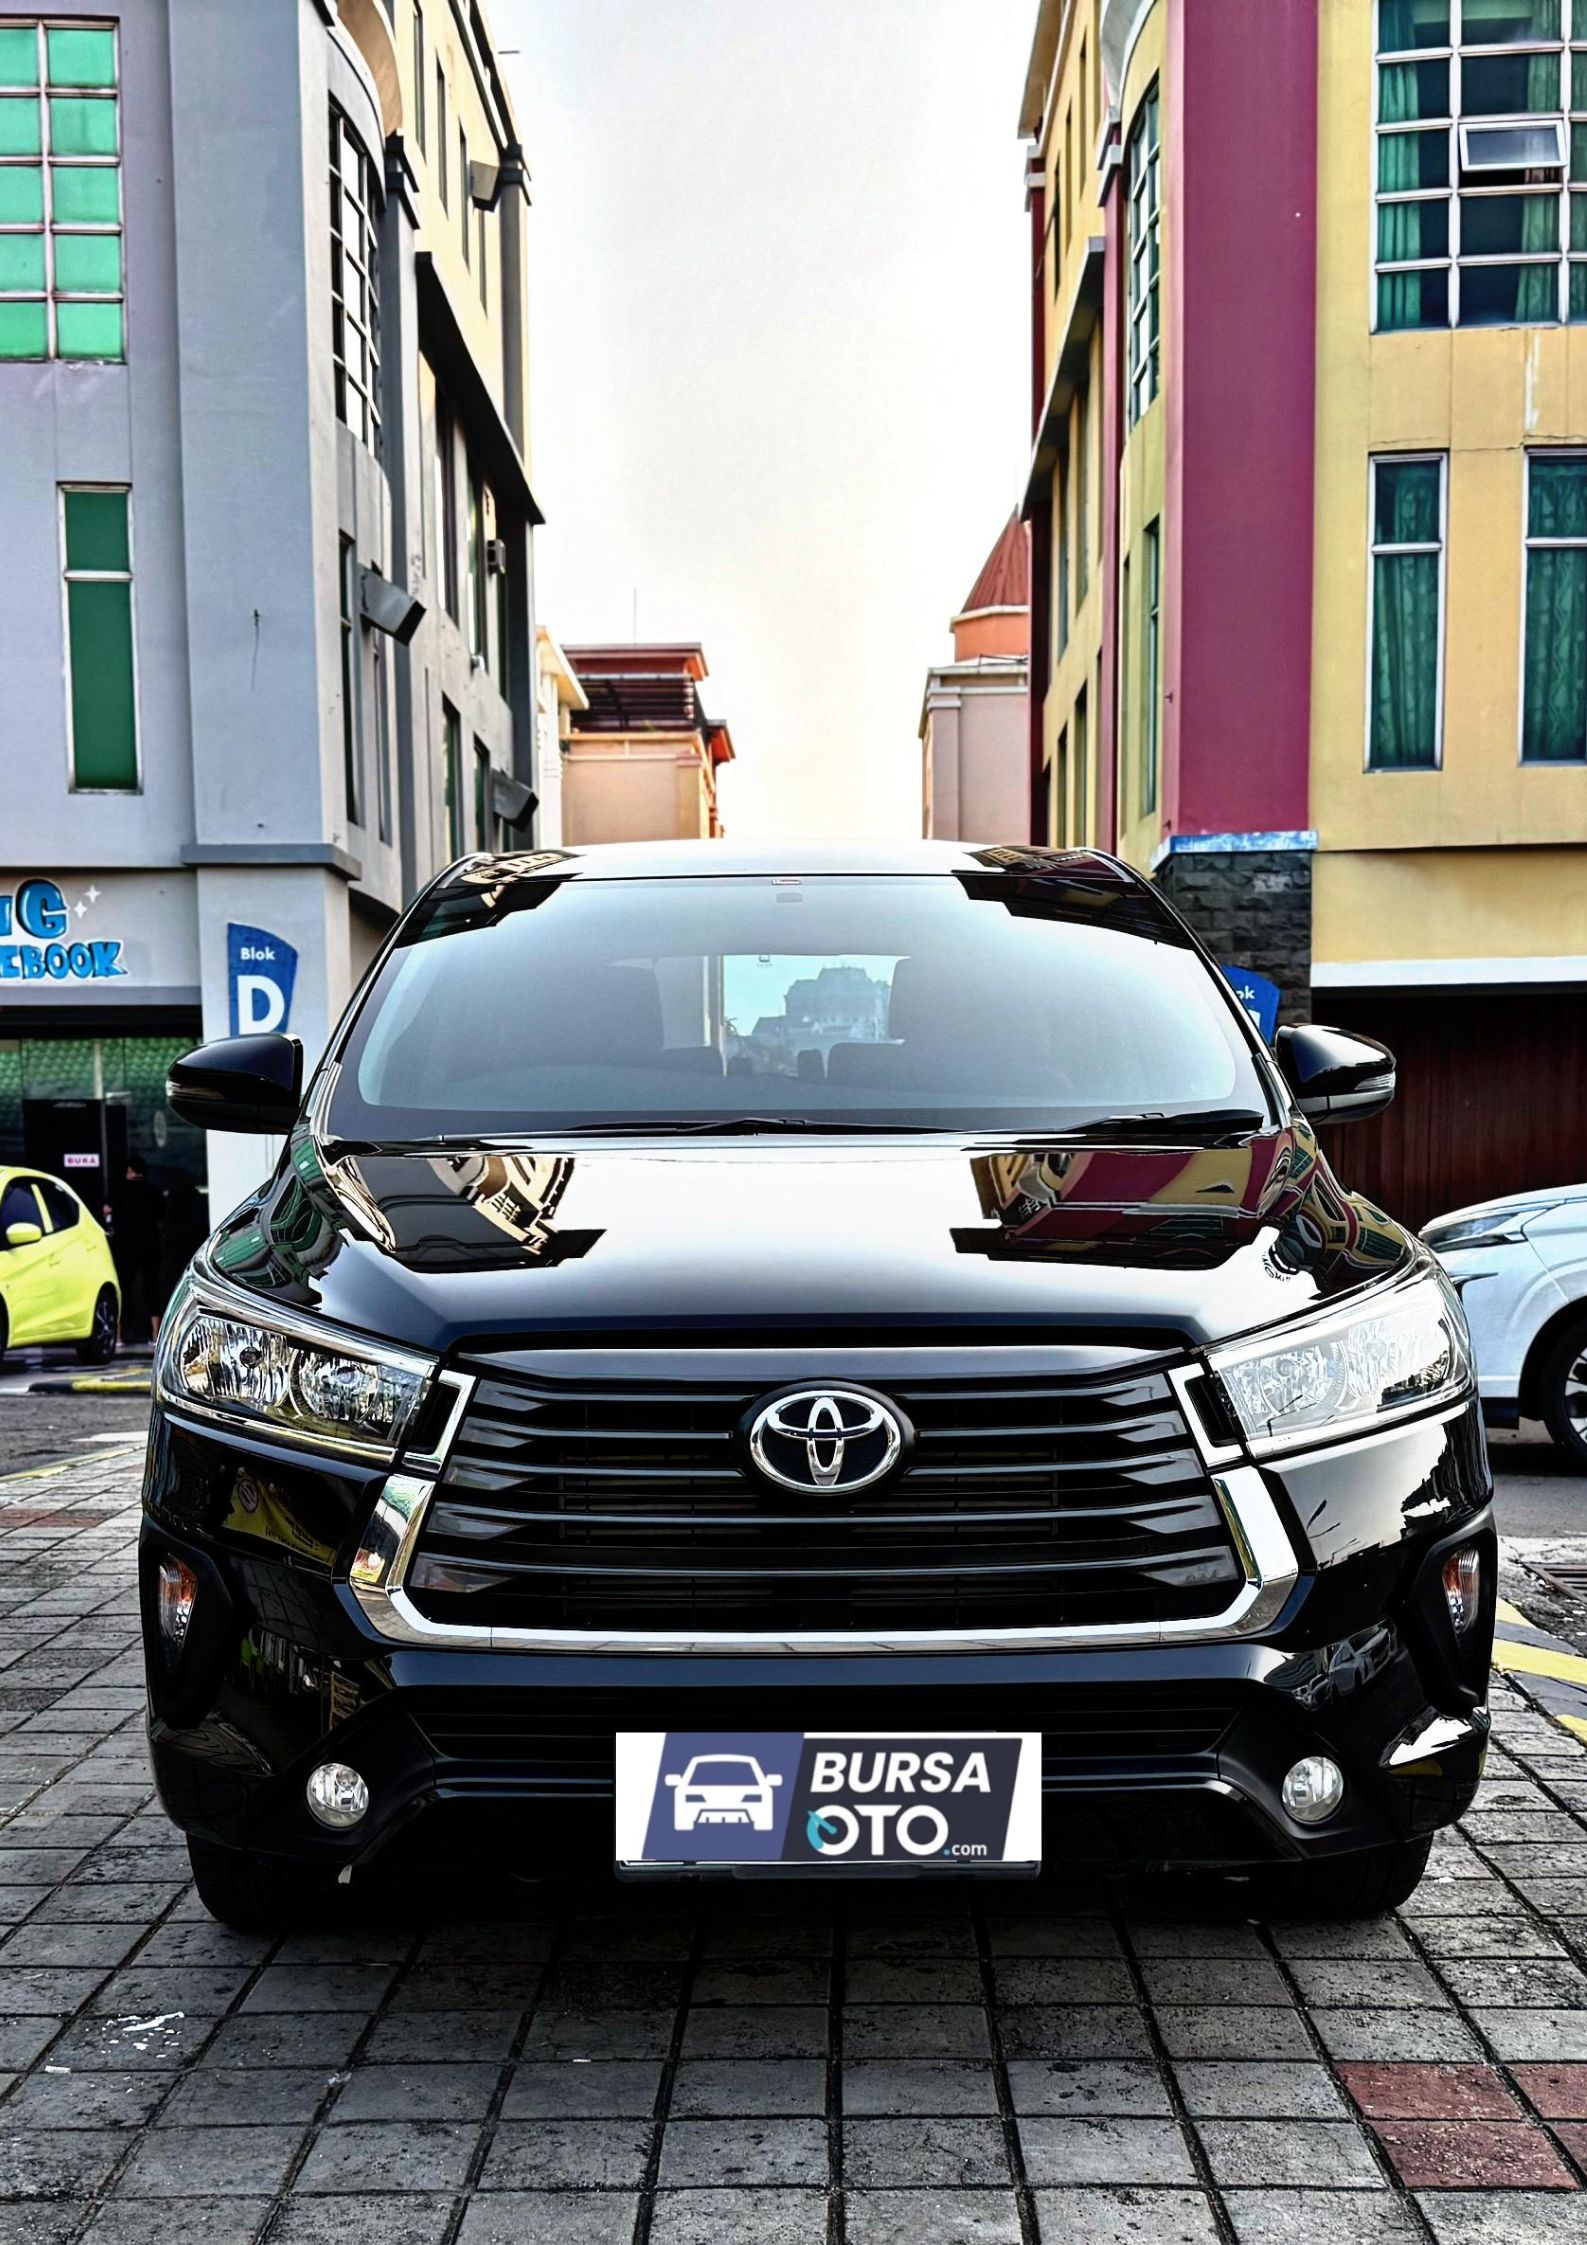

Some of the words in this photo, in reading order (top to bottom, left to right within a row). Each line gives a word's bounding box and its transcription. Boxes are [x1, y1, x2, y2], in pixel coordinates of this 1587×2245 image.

[241, 946, 275, 960] Blok
[1236, 985, 1255, 999] ok
[237, 974, 285, 1035] D
